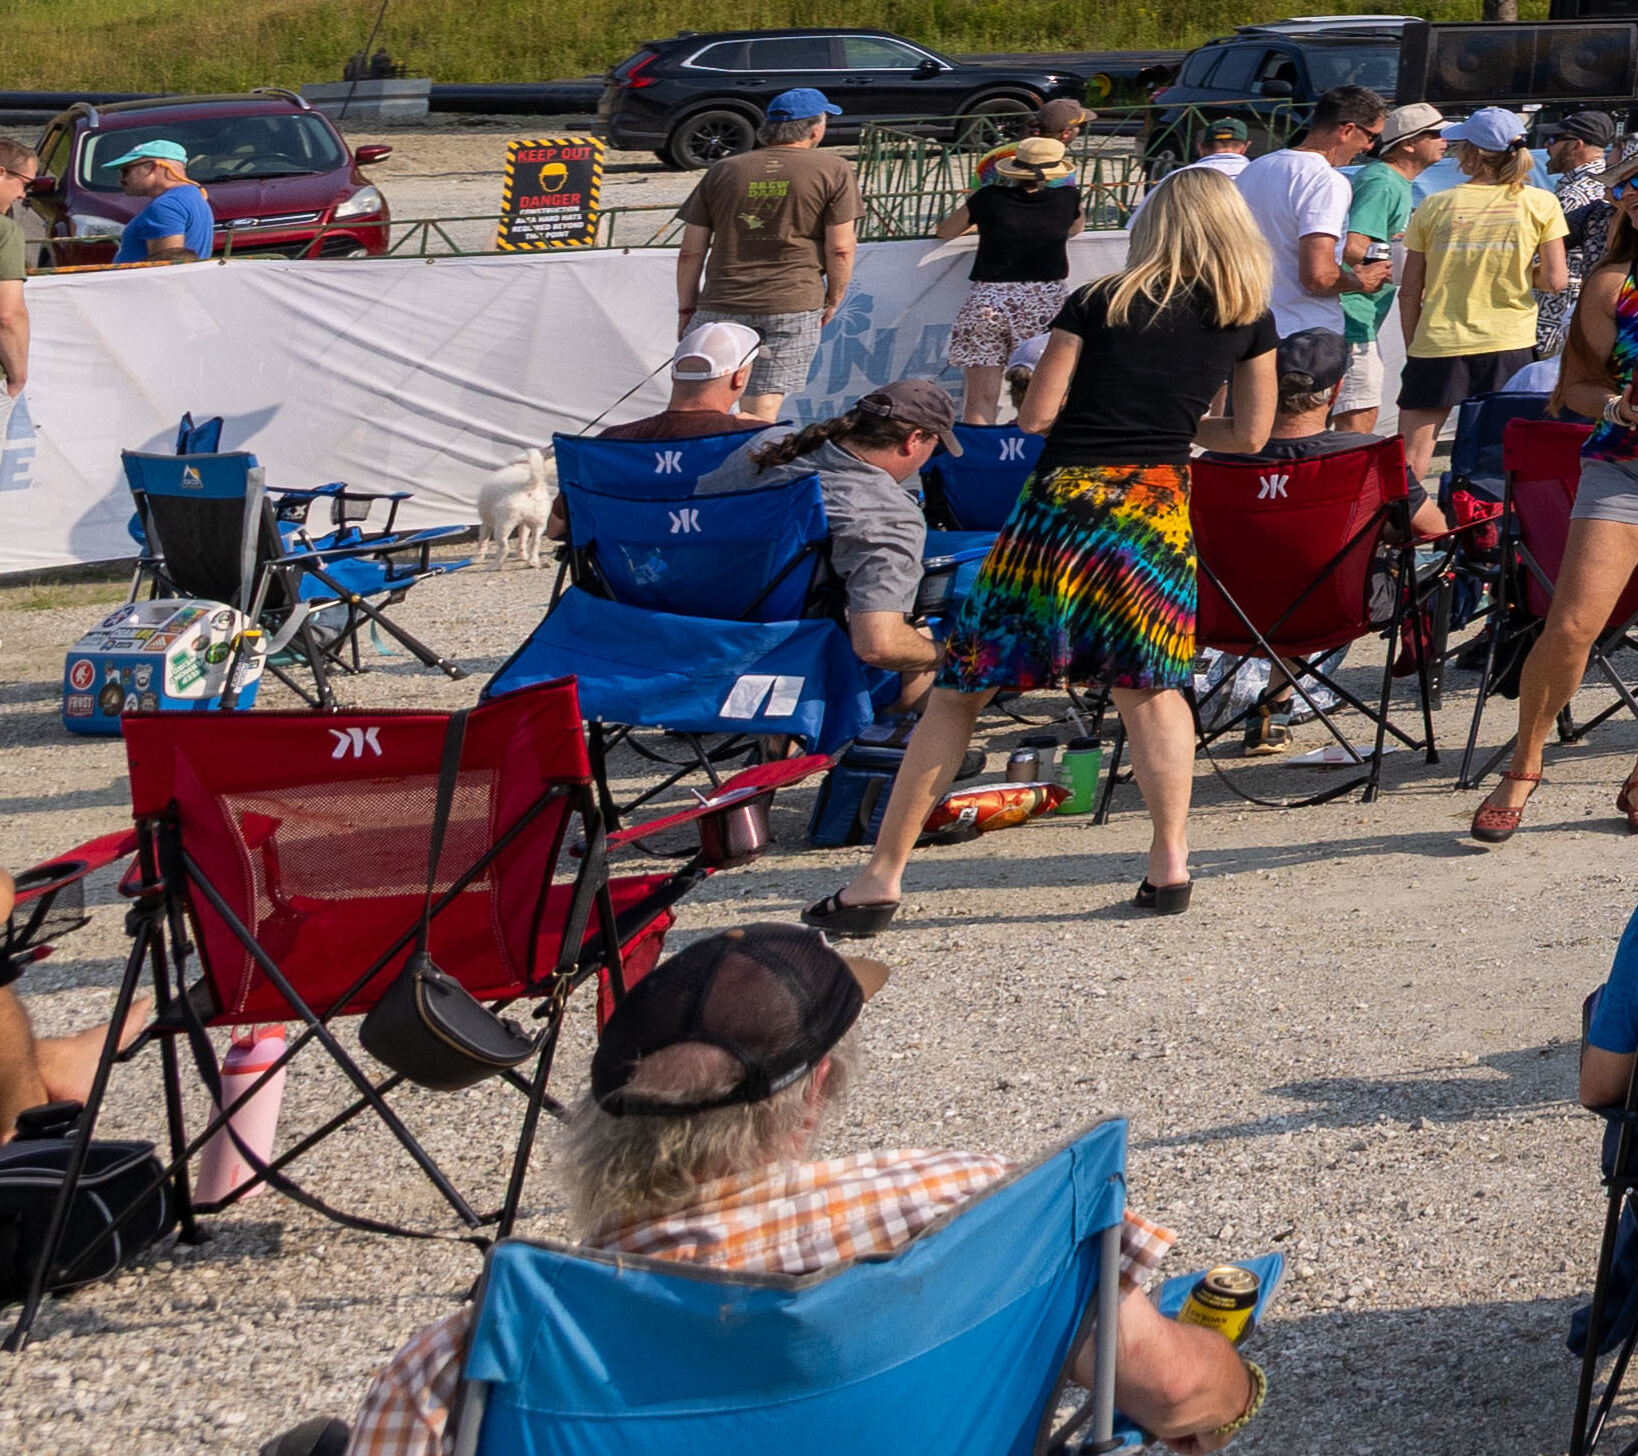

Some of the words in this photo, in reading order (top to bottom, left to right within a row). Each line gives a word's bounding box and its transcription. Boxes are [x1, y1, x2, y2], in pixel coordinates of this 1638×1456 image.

[517, 149, 557, 162] KEEP
[561, 147, 592, 160] OUT
[520, 193, 581, 208] DANGER
